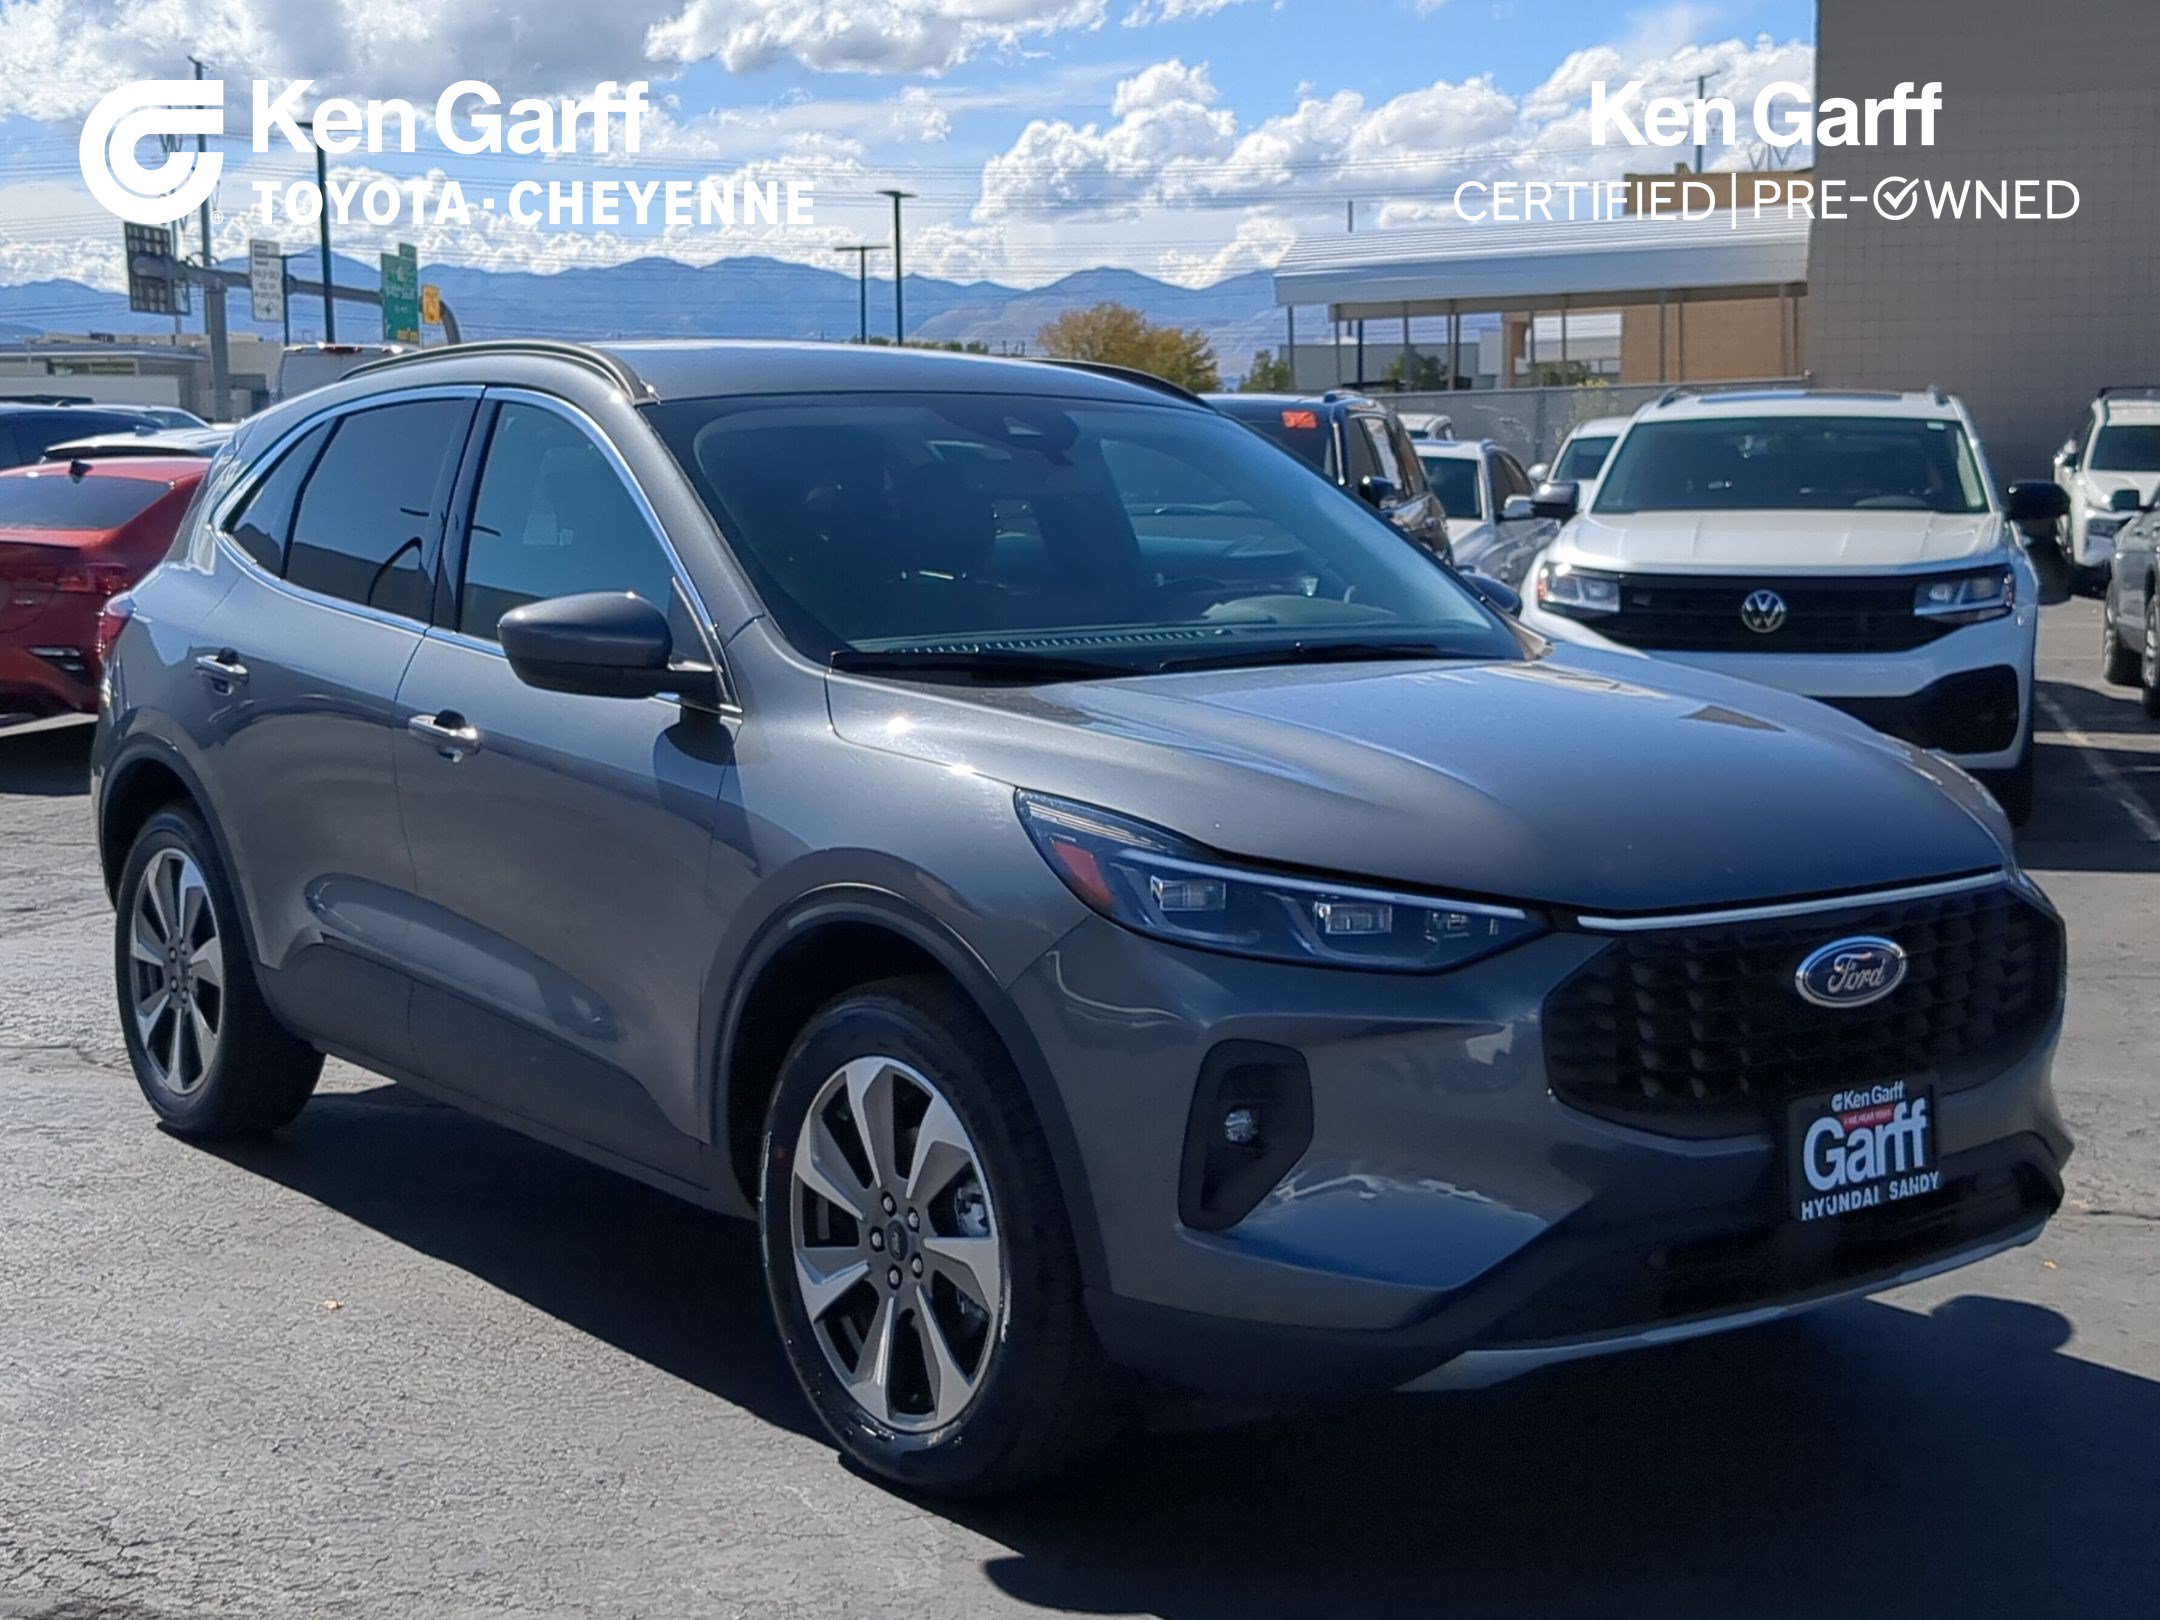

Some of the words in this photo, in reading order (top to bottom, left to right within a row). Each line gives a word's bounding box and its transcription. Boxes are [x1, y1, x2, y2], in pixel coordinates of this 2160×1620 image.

[1827, 951, 1886, 994] Ford
[1844, 1089, 1870, 1111] Ken
[1871, 1080, 1904, 1105] Garff
[1803, 1097, 1927, 1192] Garff
[1801, 1184, 1880, 1221] HYUNDAI
[1889, 1171, 1940, 1201] SANDY
